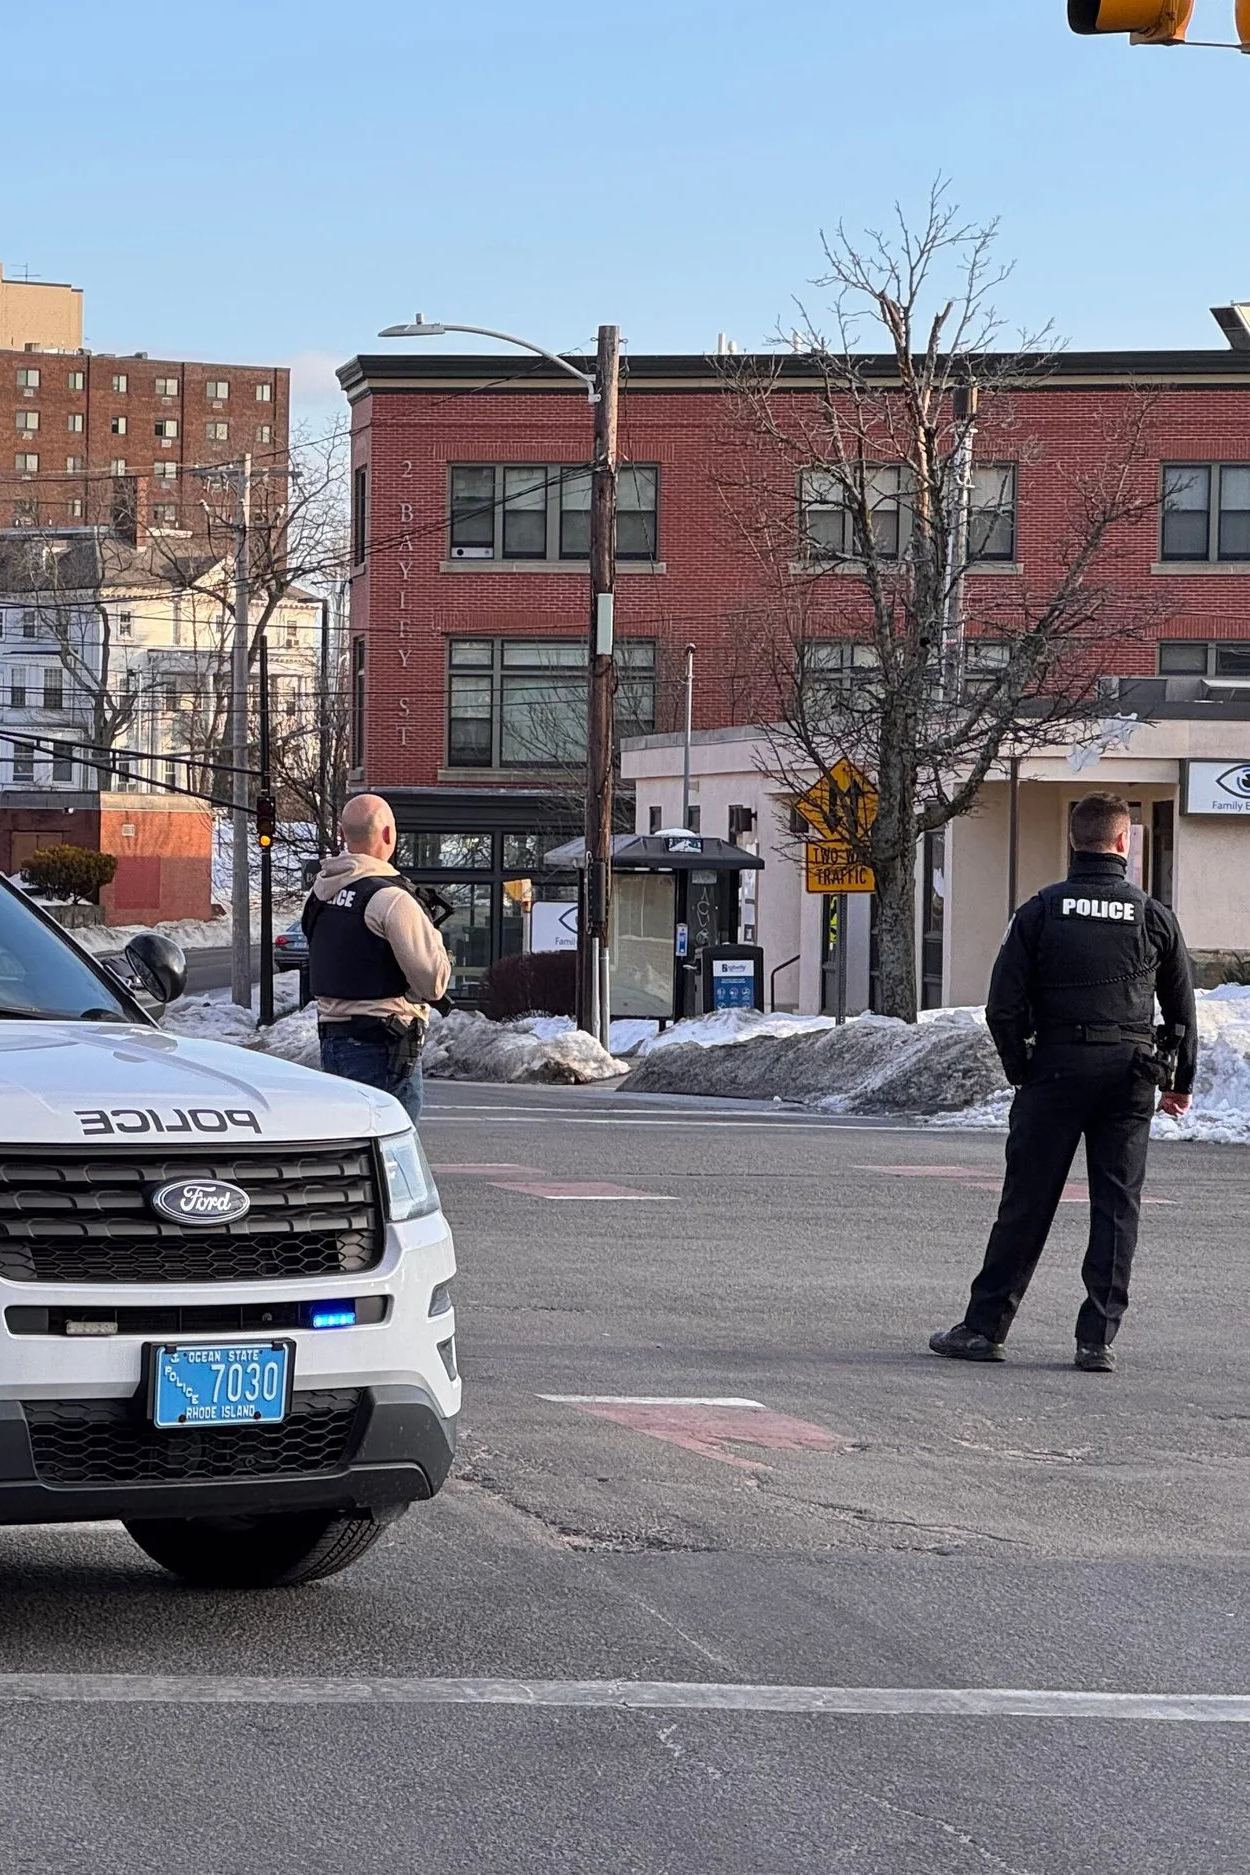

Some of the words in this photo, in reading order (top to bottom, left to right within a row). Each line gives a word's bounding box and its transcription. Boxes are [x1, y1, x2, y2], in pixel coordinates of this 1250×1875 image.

[397, 503, 414, 667] BAYLEY
[395, 698, 412, 746] ST
[1212, 801, 1244, 812] Family
[816, 868, 867, 885] TRAFFIC
[1062, 898, 1135, 921] POLICE
[554, 937, 576, 946] Famil
[180, 1186, 232, 1213] Ford
[188, 1350, 221, 1363] OCEAN
[227, 1350, 259, 1363] STATE
[164, 1365, 199, 1405] POLICE
[210, 1361, 279, 1403] 7030
[186, 1406, 217, 1420] RHODE
[221, 1404, 256, 1419] ISLAND
